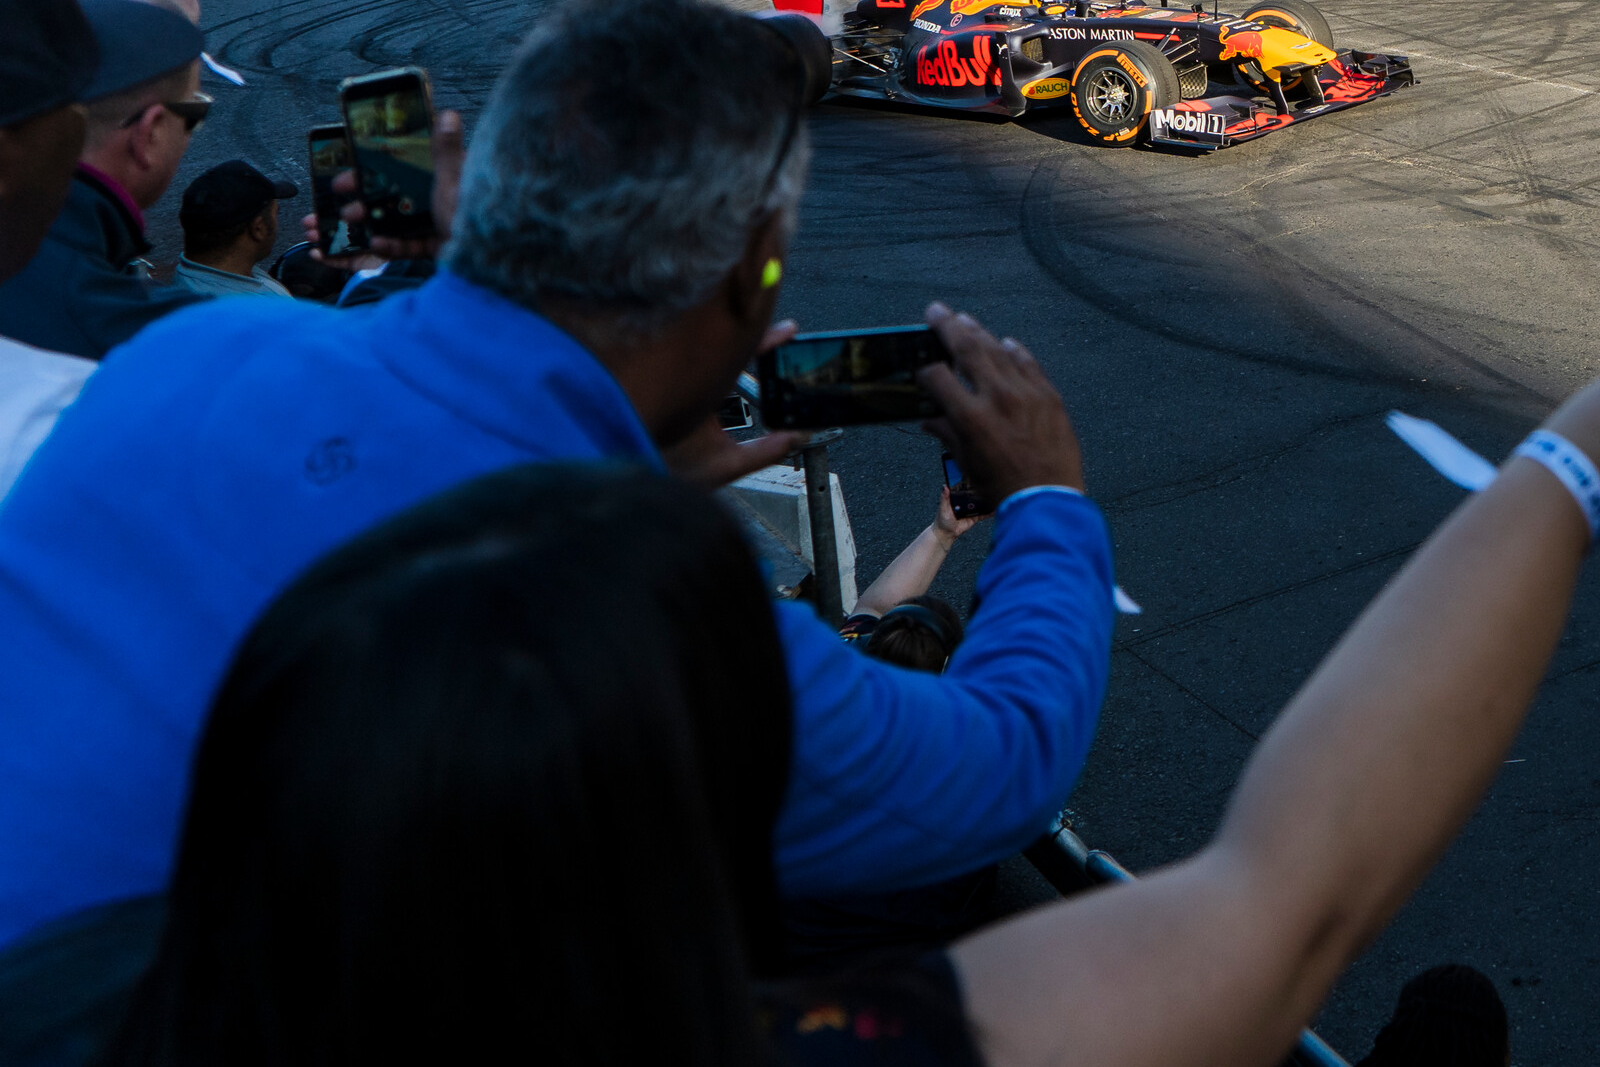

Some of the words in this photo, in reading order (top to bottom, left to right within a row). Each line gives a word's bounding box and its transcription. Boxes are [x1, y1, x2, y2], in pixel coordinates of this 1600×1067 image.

[913, 18, 942, 33] HONDA
[1048, 28, 1086, 40] ASTON
[1090, 29, 1135, 40] MARTIN
[1036, 83, 1068, 94] RAUCH
[1155, 109, 1206, 133] Mobil
